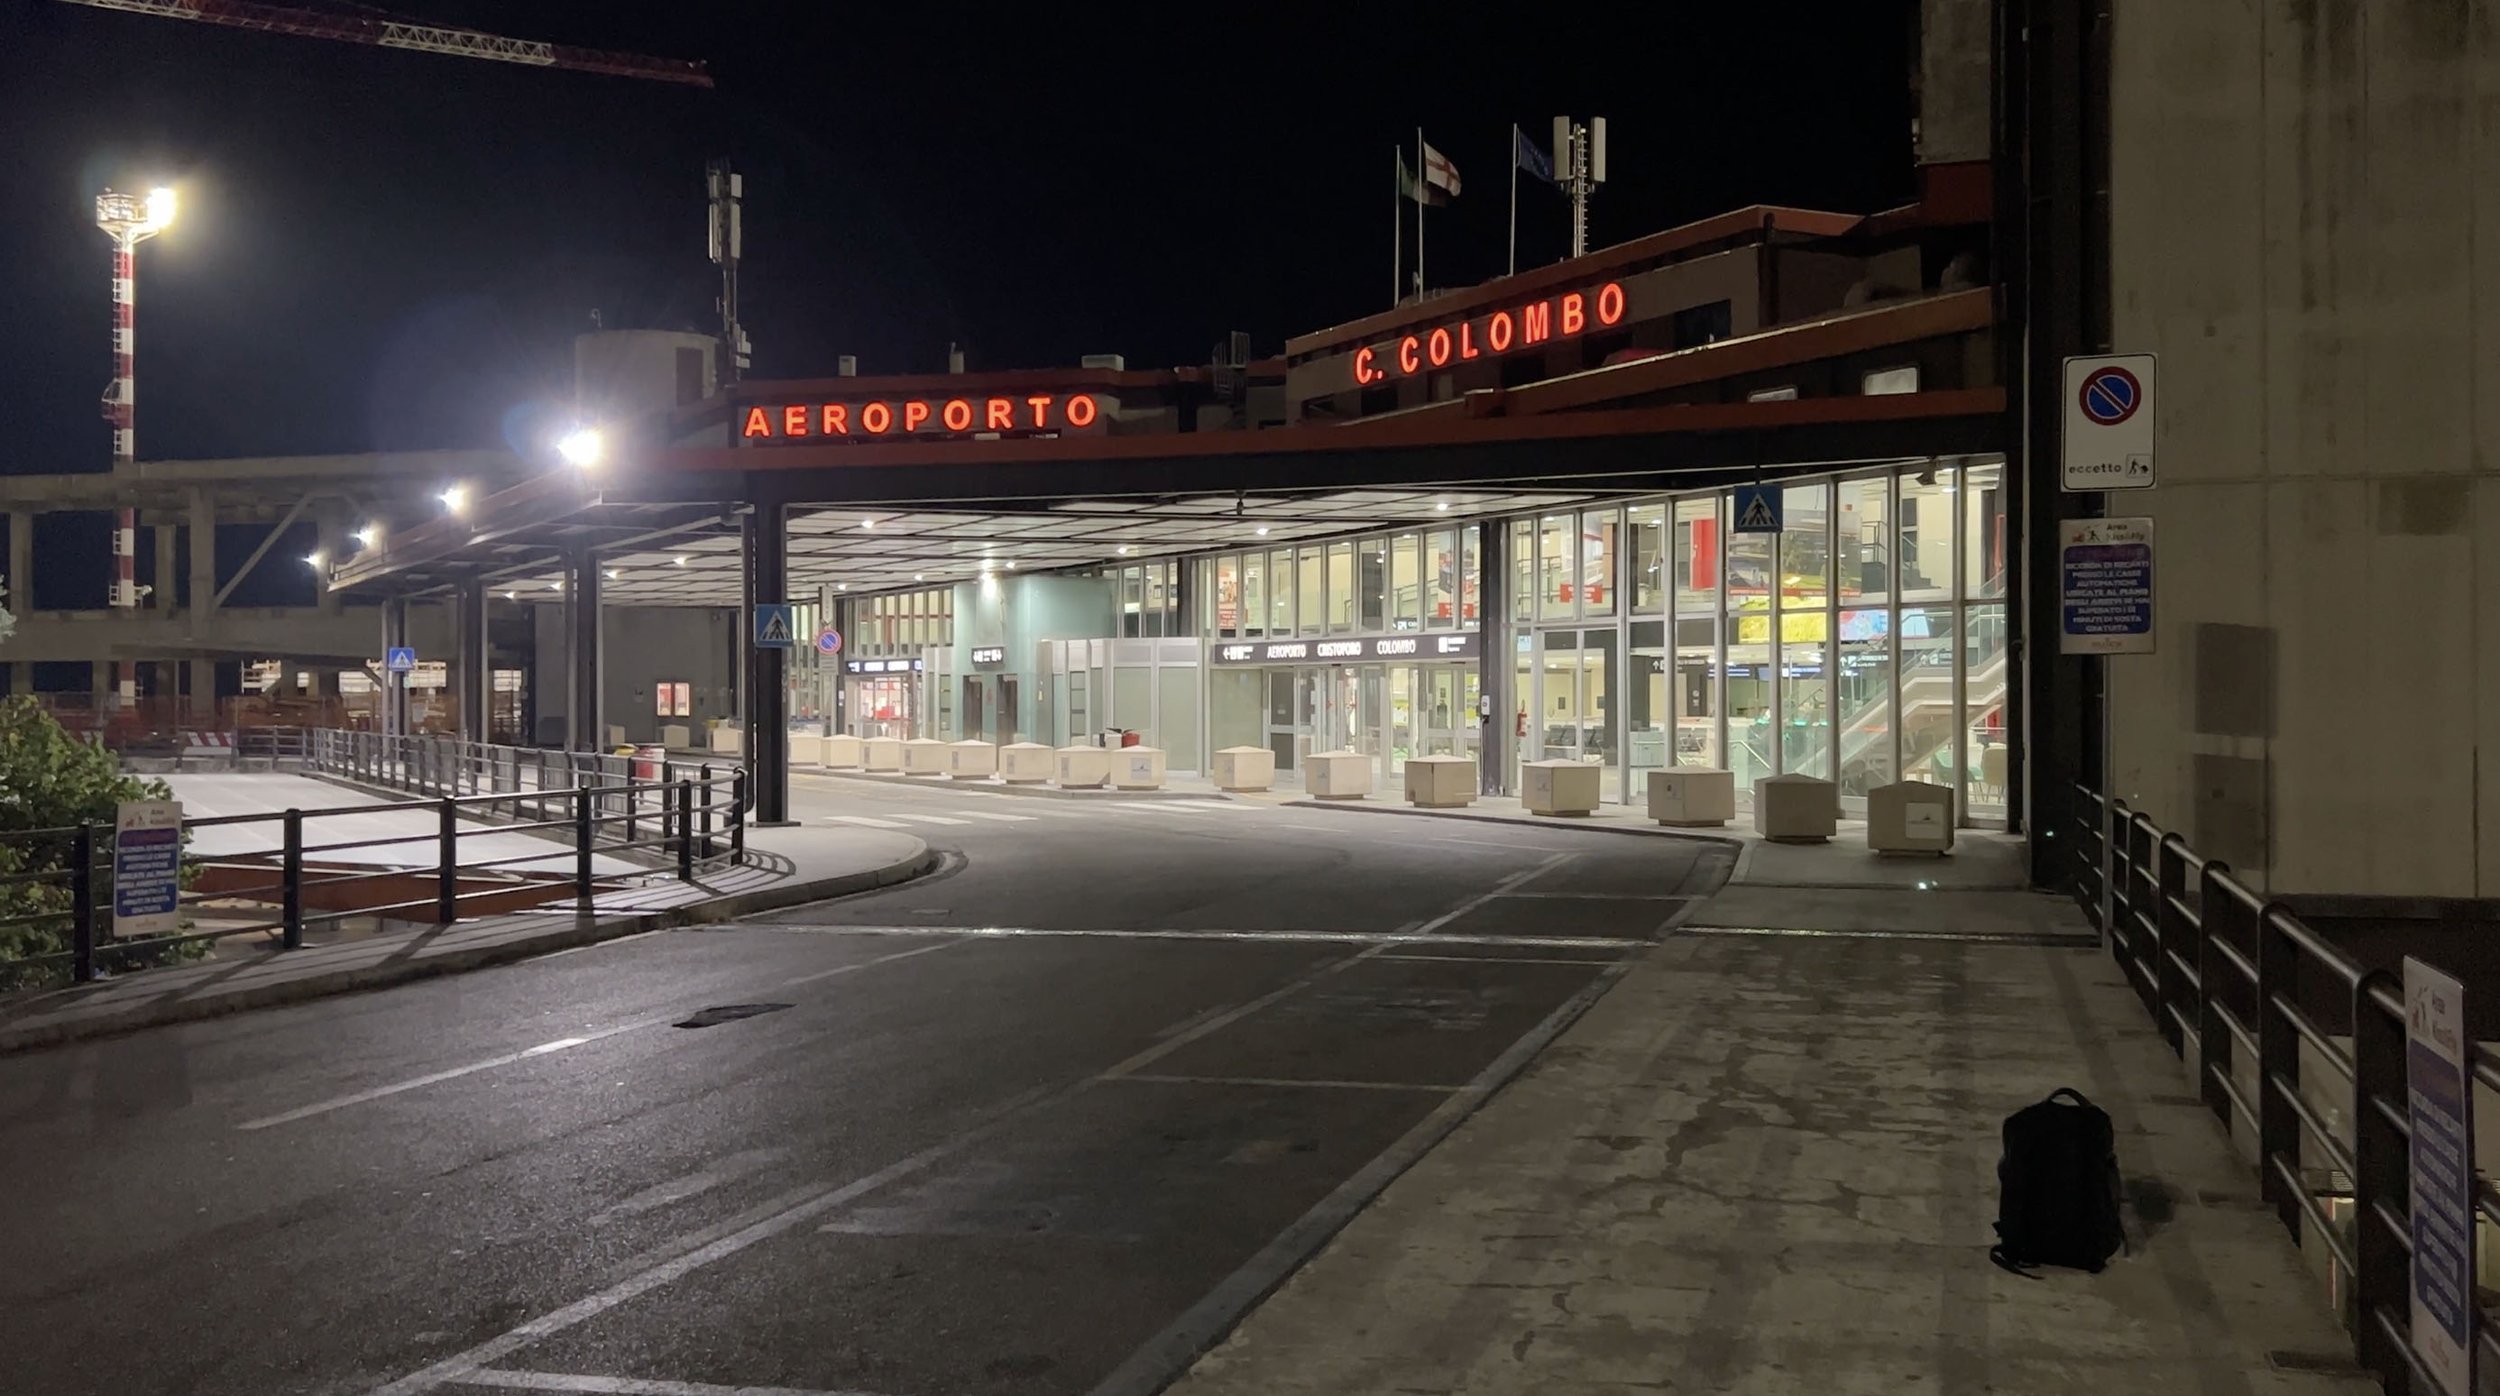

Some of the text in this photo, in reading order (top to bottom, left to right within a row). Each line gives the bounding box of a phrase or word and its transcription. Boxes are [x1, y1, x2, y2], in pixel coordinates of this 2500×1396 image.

[1356, 283, 1625, 384] C. COLOMBO
[744, 395, 1096, 437] AEROPORTO
[2068, 463, 2122, 474] eccetto
[1267, 644, 1307, 660] AEROPORTO
[1317, 641, 1361, 657] CRISTOFORO
[1377, 639, 1416, 654] COLOMBO
